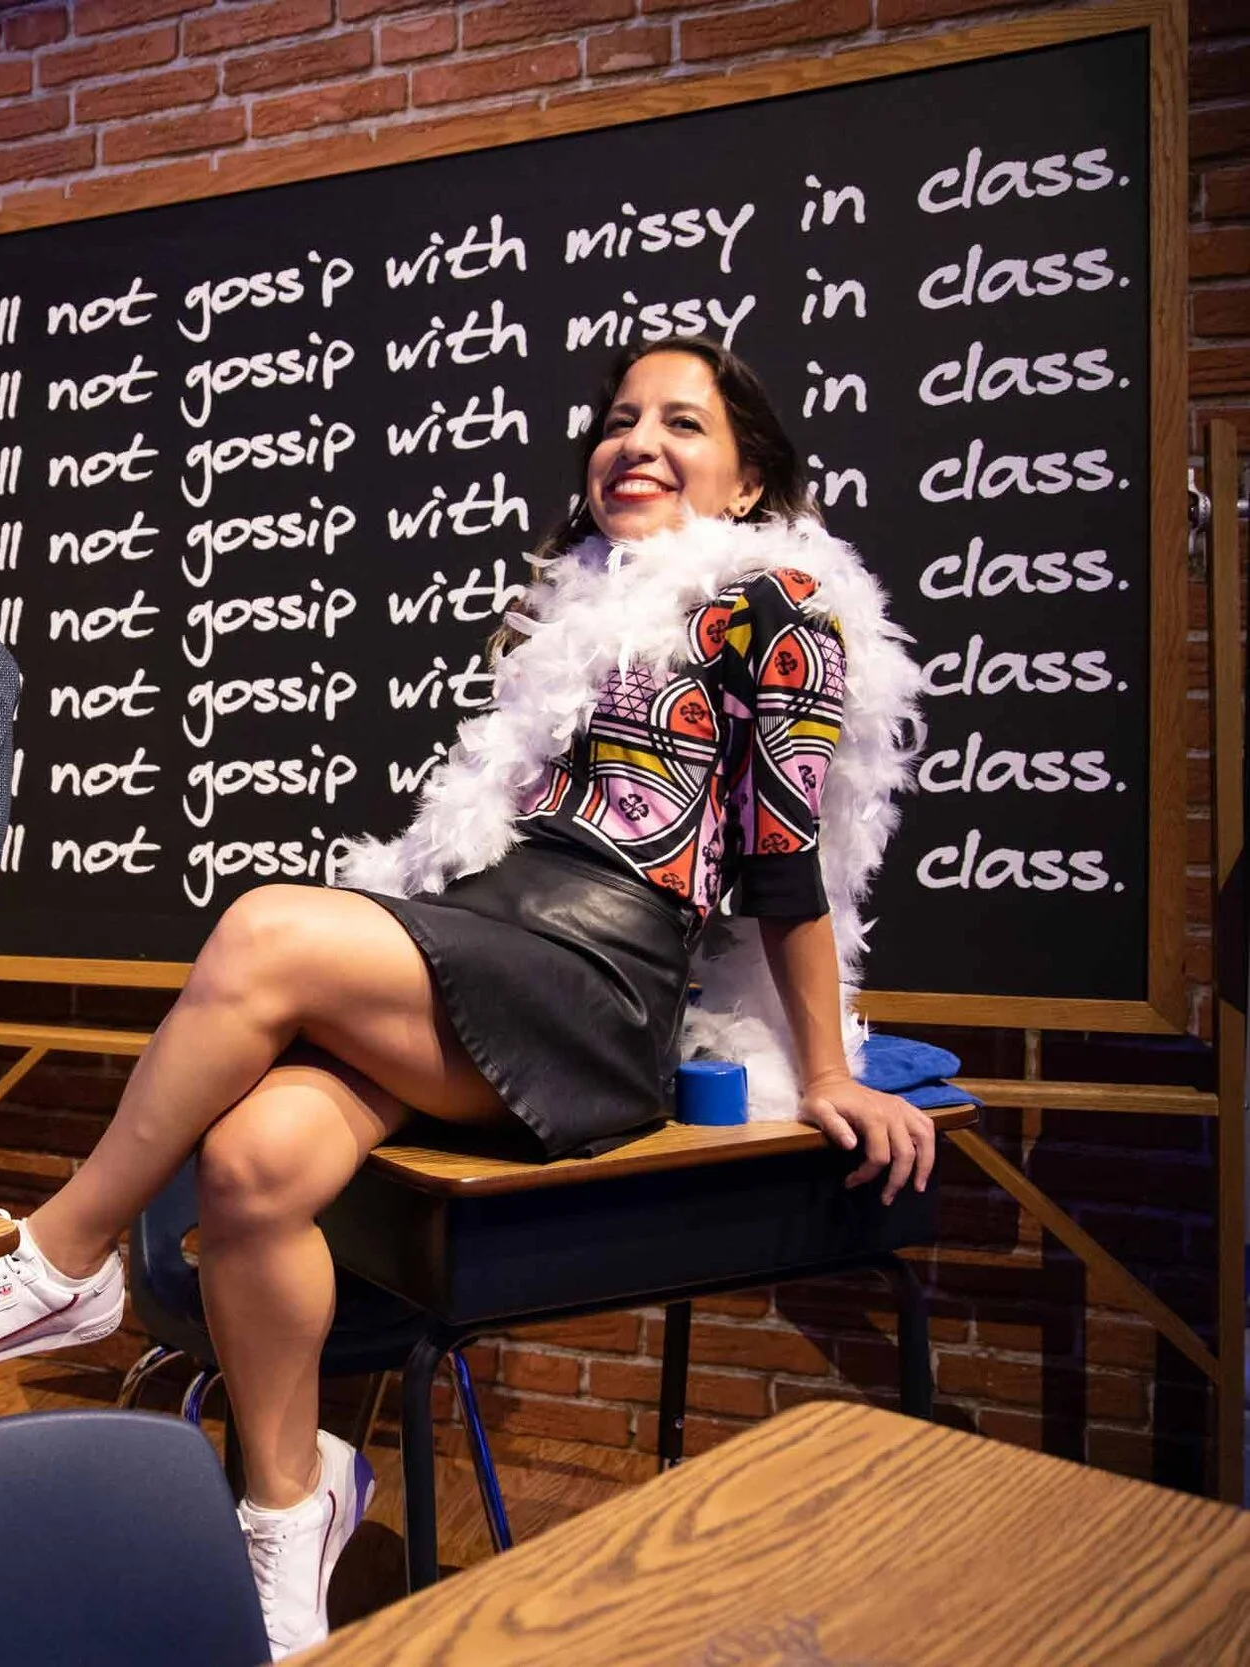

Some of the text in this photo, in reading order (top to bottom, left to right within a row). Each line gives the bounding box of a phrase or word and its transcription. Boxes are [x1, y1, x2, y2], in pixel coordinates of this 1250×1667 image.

[48, 277, 158, 335] not
[386, 214, 527, 289] with
[565, 203, 755, 274] missy
[801, 175, 866, 232] in
[918, 147, 1130, 214] class.
[48, 355, 159, 411] not
[180, 332, 355, 428] gossip
[386, 300, 528, 373] with
[566, 291, 756, 352] missy
[802, 268, 867, 325] in
[918, 244, 1130, 310] class.
[48, 433, 159, 488] not
[181, 414, 356, 508] gossip
[387, 386, 529, 457] with
[803, 361, 868, 419] in
[918, 341, 1130, 407] class.
[49, 511, 160, 565] not
[181, 496, 357, 588] gossip
[388, 472, 530, 541] with
[807, 455, 868, 508] in
[919, 438, 1130, 503] class.
[49, 590, 161, 642] not
[182, 579, 357, 668] gossip
[389, 558, 526, 625] with
[919, 536, 1129, 600] class.
[50, 668, 161, 720] not
[182, 662, 358, 748] gossip
[389, 655, 496, 710] wit
[920, 634, 1128, 697] class.
[50, 747, 161, 797] not
[183, 744, 358, 828] gossip
[917, 731, 1127, 793] class.
[0, 824, 1125, 908] ll not gossip class.
